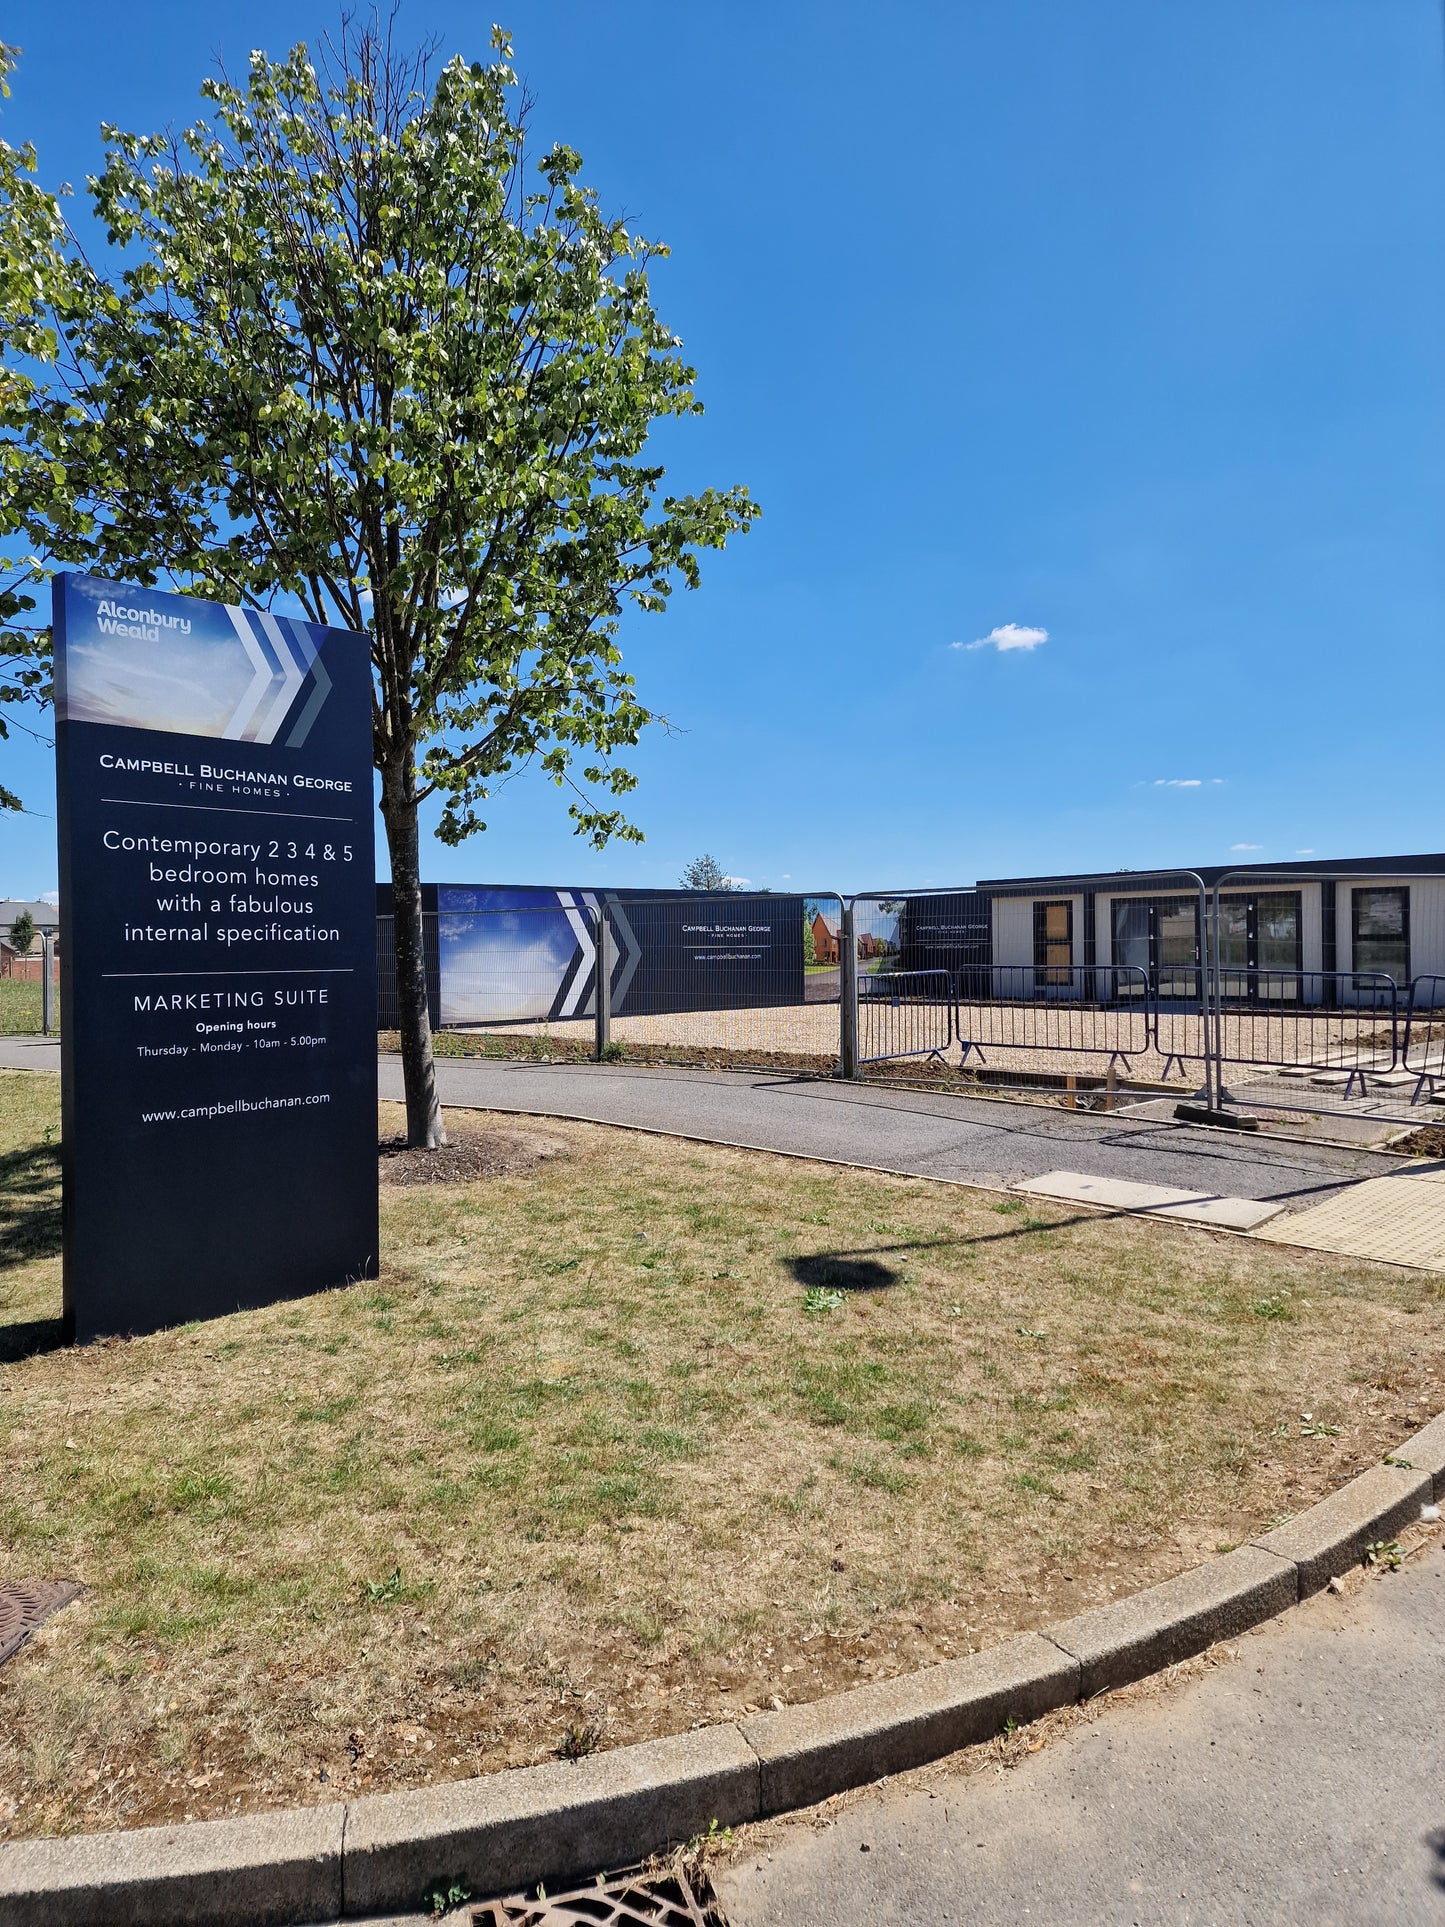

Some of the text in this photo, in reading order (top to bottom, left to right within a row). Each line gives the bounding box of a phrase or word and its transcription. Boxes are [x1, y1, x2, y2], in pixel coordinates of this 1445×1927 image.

[97, 600, 191, 635] Alconbury
[97, 616, 159, 642] Weald
[99, 754, 353, 793] CAMPBELL BUCHANAN GEORGE
[189, 781, 281, 798] FINE HOMES
[103, 830, 353, 862] Contemporary 2 3 4 & 5
[150, 862, 319, 887] bedroom homes
[156, 893, 314, 914] with a fabulous
[125, 922, 340, 947] internal specification
[134, 989, 329, 1012] MARKETING SUITE
[195, 1020, 277, 1034] Opening hours
[137, 1044, 189, 1057] Thursday
[200, 1042, 243, 1053] Monday
[253, 1038, 280, 1049] 10am
[290, 1035, 327, 1047] 5.00pm
[141, 1093, 331, 1123] www.campbellbuchanan.com
